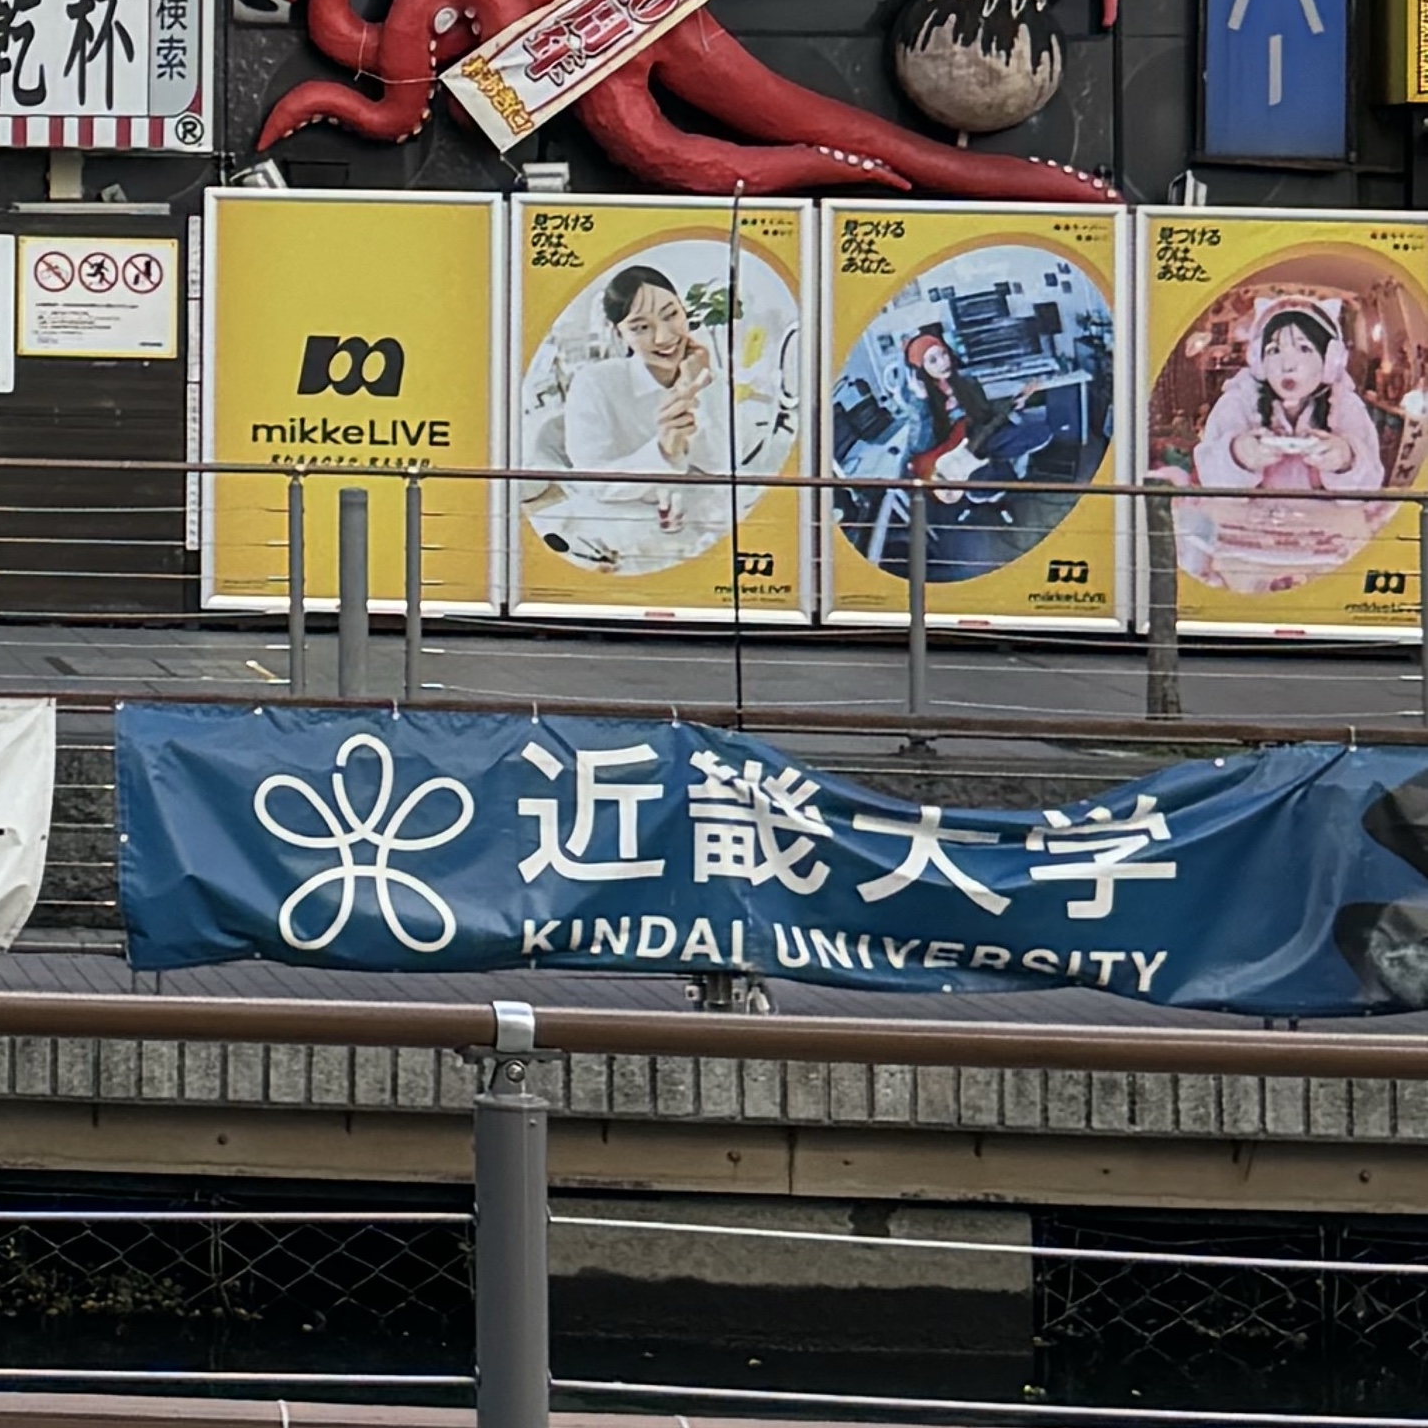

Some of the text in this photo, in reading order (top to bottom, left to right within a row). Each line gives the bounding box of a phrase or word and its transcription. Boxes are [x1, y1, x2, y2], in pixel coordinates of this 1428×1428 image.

[252, 417, 451, 447] mikkeLIVE
[517, 740, 1177, 920] 近畿大学
[521, 915, 1168, 993] KINDAI UNIVERSITY
